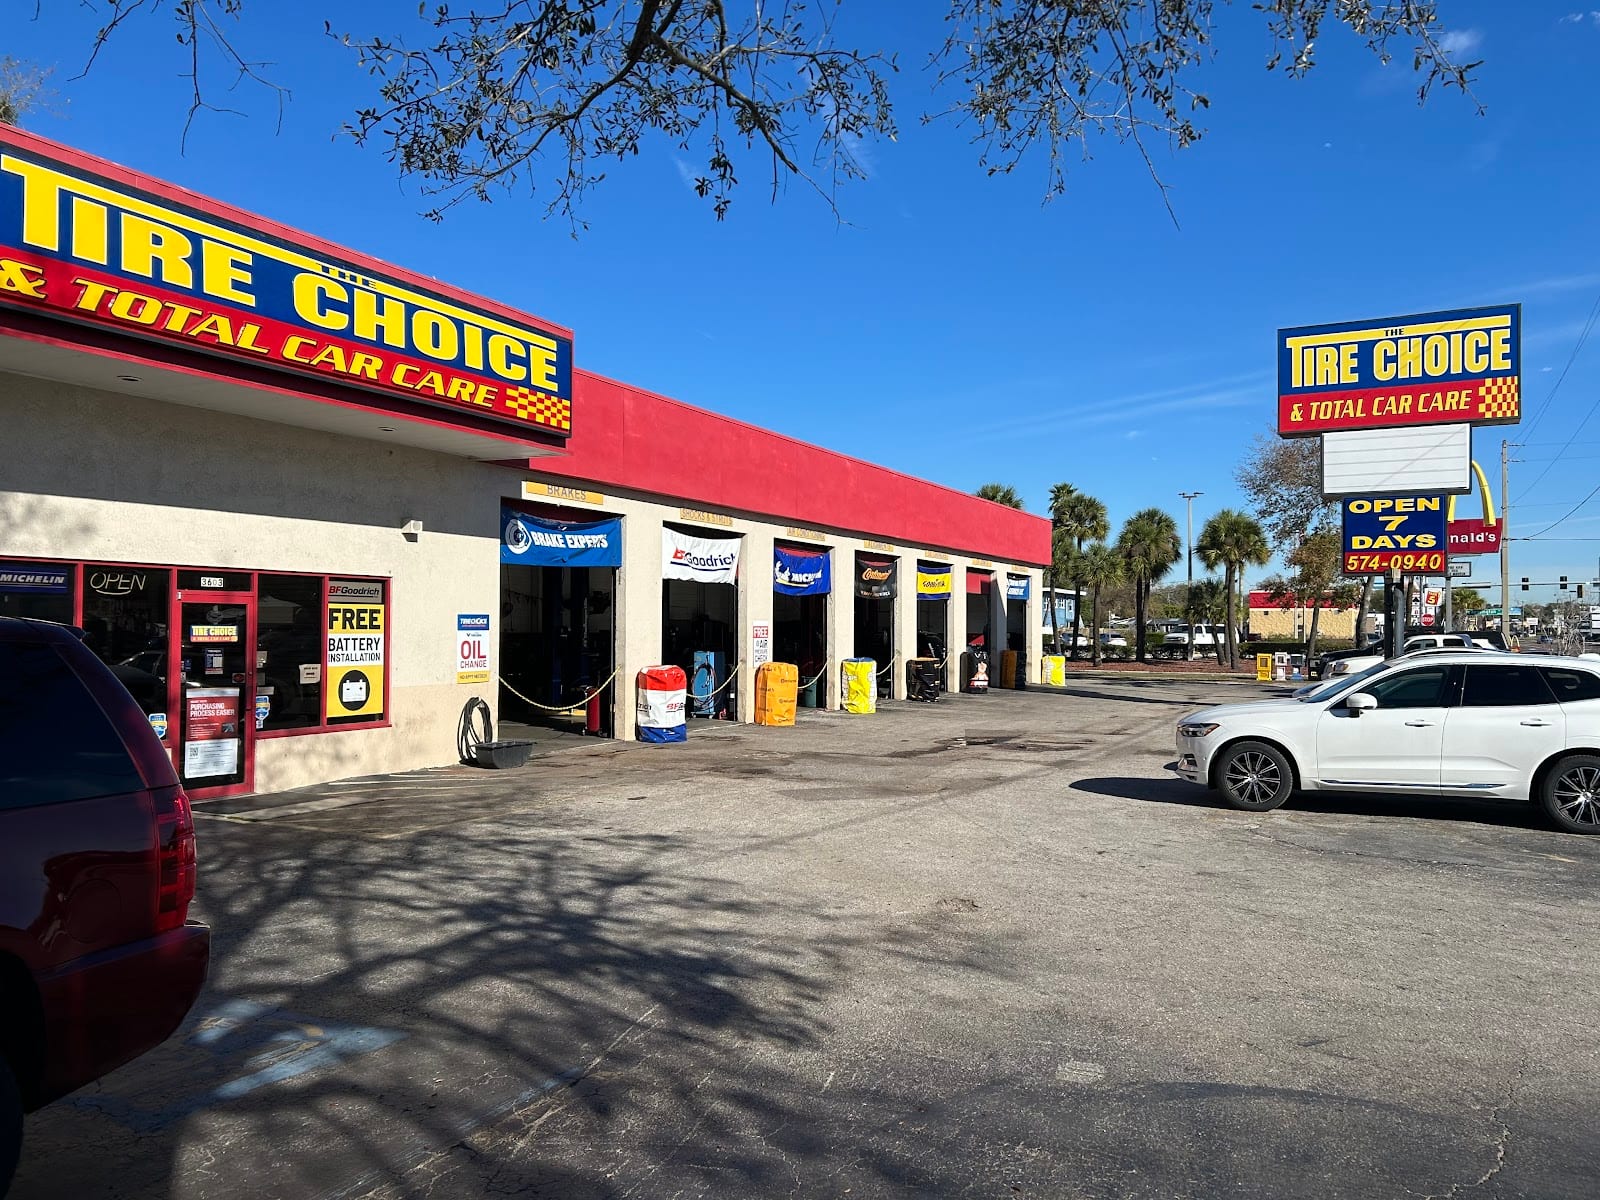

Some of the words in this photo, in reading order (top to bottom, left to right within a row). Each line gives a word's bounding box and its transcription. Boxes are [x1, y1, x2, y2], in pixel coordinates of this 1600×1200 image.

[0, 153, 256, 307] TIRE
[293, 272, 558, 392] CHOICE
[318, 262, 377, 290] THE
[0, 257, 46, 299] &
[75, 278, 269, 354] TOTAL
[281, 334, 384, 380] CAR
[390, 360, 499, 408] CARE
[1384, 328, 1404, 337] THE
[1286, 337, 1359, 388] TIRE
[1373, 328, 1511, 381] CHOICE
[1290, 403, 1303, 421] &
[1310, 398, 1366, 420] TOTAL
[1372, 395, 1413, 415] CAR
[1417, 390, 1473, 413] CARE
[547, 484, 586, 500] BRAKES
[1348, 497, 1440, 514] OPEN
[1378, 515, 1408, 532] 7
[530, 530, 567, 548] BRAKE
[565, 534, 608, 549] EXPERTS
[1351, 534, 1437, 550] DAYS
[1450, 532, 1496, 544] nald's
[1347, 553, 1441, 571] 574-0940
[0, 573, 65, 584] MICHELIN
[90, 572, 146, 590] OPEN
[201, 577, 223, 587] 3603
[328, 585, 380, 596] BFGoodrich
[328, 608, 381, 630] FREE
[328, 637, 381, 652] BATTERY
[461, 640, 487, 660] OIL
[328, 652, 381, 663] INSTALLATION
[460, 660, 487, 669] CHANGE
[190, 702, 225, 710] PURCHASING
